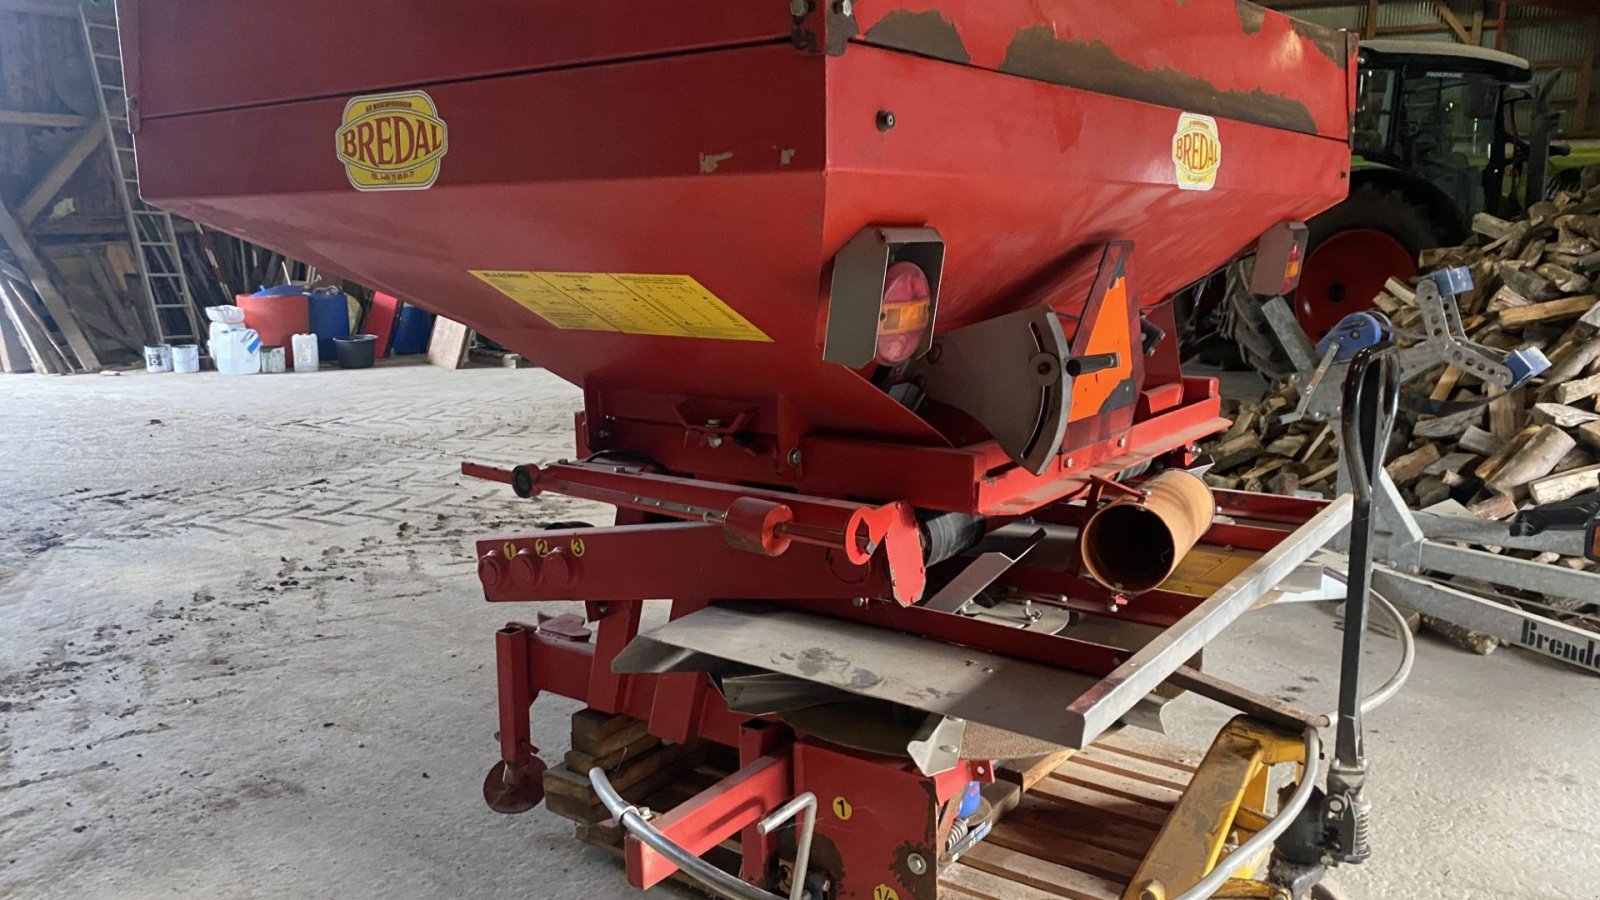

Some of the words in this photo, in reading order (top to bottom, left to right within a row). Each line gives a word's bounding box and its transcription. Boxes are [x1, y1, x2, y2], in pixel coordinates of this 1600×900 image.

[342, 115, 442, 168] BREDAL
[1176, 132, 1218, 170] BREDAL
[505, 543, 512, 558] 1
[537, 540, 547, 555] 2
[574, 540, 582, 555] 3
[837, 799, 846, 817] 1
[876, 888, 894, 900] 1/
